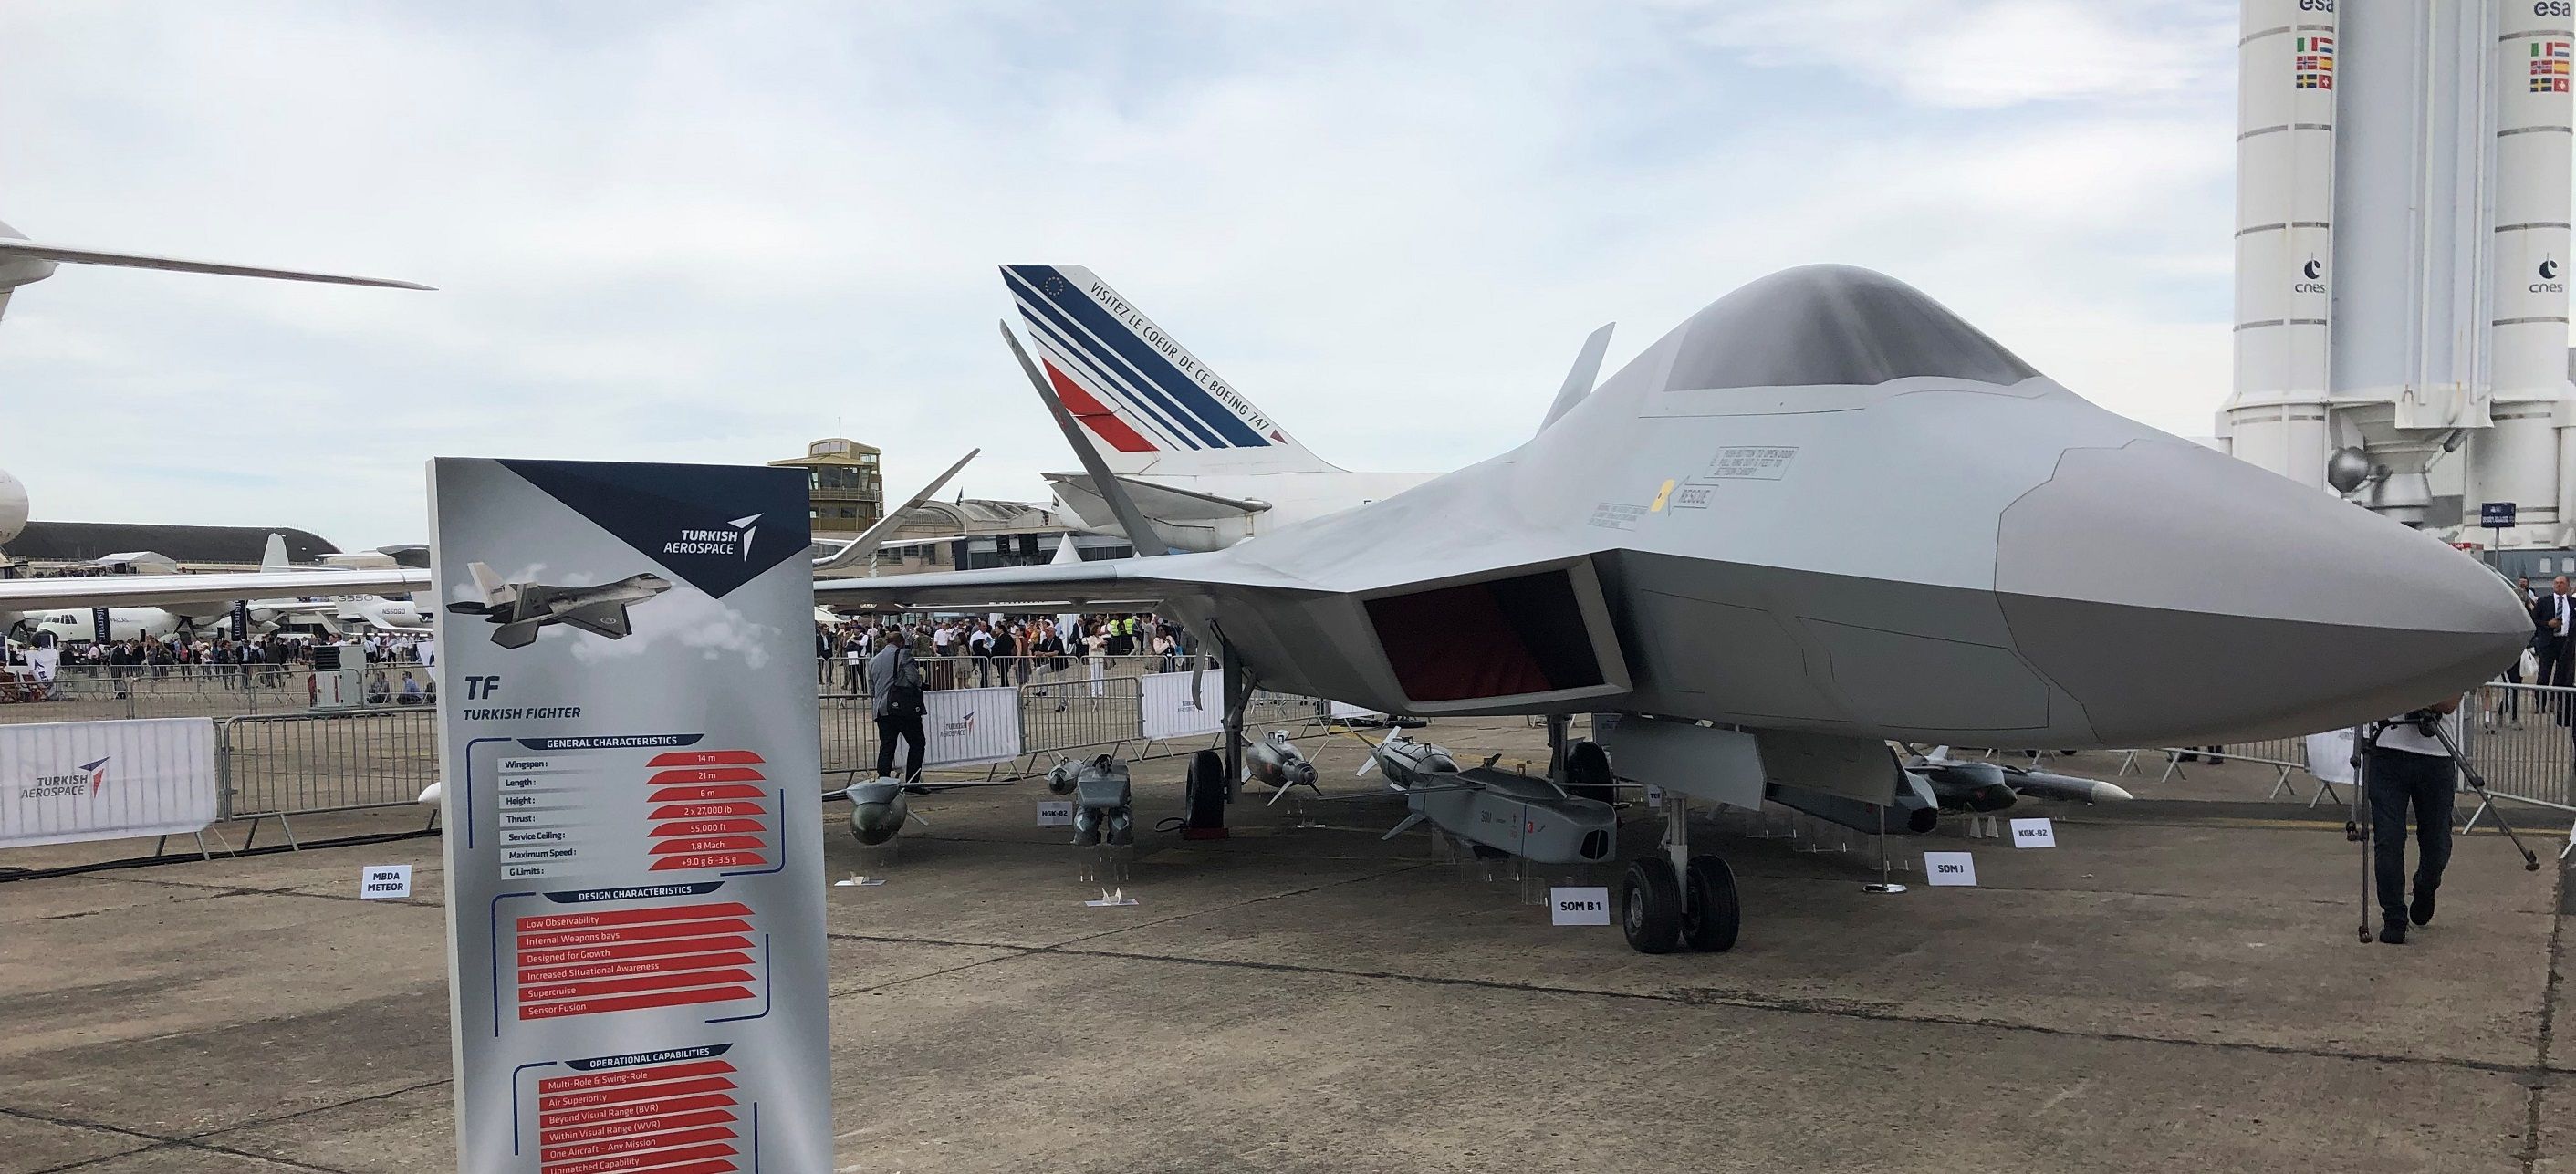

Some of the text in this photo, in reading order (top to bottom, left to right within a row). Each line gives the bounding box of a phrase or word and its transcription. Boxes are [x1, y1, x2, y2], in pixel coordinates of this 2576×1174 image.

[2300, 0, 2334, 13] esa
[2533, 1, 2571, 17] esa
[2295, 283, 2326, 294] cnes
[2529, 283, 2563, 294] cnes
[1090, 282, 1270, 431] VISITEZ LE COEUR DE CE BOEING 747
[682, 530, 738, 543] TURKISH
[663, 542, 734, 555] AEROSPACE
[338, 594, 374, 602] G550
[464, 675, 500, 700] TF
[463, 706, 581, 721] TURKISH FIGHTER
[547, 736, 677, 748] GENERAL CHARACTERISTICS
[37, 774, 88, 787] TURKISH
[698, 772, 706, 780] 21
[21, 785, 84, 799] AEROSPACE
[508, 833, 536, 841] Service
[2018, 829, 2048, 837] KGK-82
[704, 841, 725, 849] Mach
[508, 850, 548, 859] Maximum
[701, 858, 706, 867] g
[732, 857, 737, 865] g
[1937, 865, 1958, 873] SOM
[373, 872, 400, 881] MBDA
[367, 883, 404, 892] METEOR
[579, 886, 692, 901] DESIGN CHARACTERISTICS
[1560, 901, 1585, 911] SOM
[527, 916, 600, 929] Low Observability
[527, 931, 620, 946] Internal Weapons bays
[527, 949, 610, 963] Designed for Growth
[527, 962, 660, 981] Increased Situational Awareness
[528, 987, 577, 998] Supercruise
[528, 1003, 587, 1015] Sensor Fusion
[589, 1048, 710, 1068] OPERATIONAL CAPABILITIES
[548, 1072, 648, 1090] Multi-Role & Swing-Role
[548, 1095, 608, 1107] Air Superiority
[549, 1104, 659, 1125] Beyond Visual Range (BVR)
[549, 1120, 661, 1141] Within Visual Range (WVR)
[550, 1150, 567, 1158] One
[568, 1145, 600, 1157] Aircraft
[607, 1142, 623, 1152] Any
[625, 1139, 656, 1149] Mission
[550, 1158, 640, 1174] Unmatched Capability
